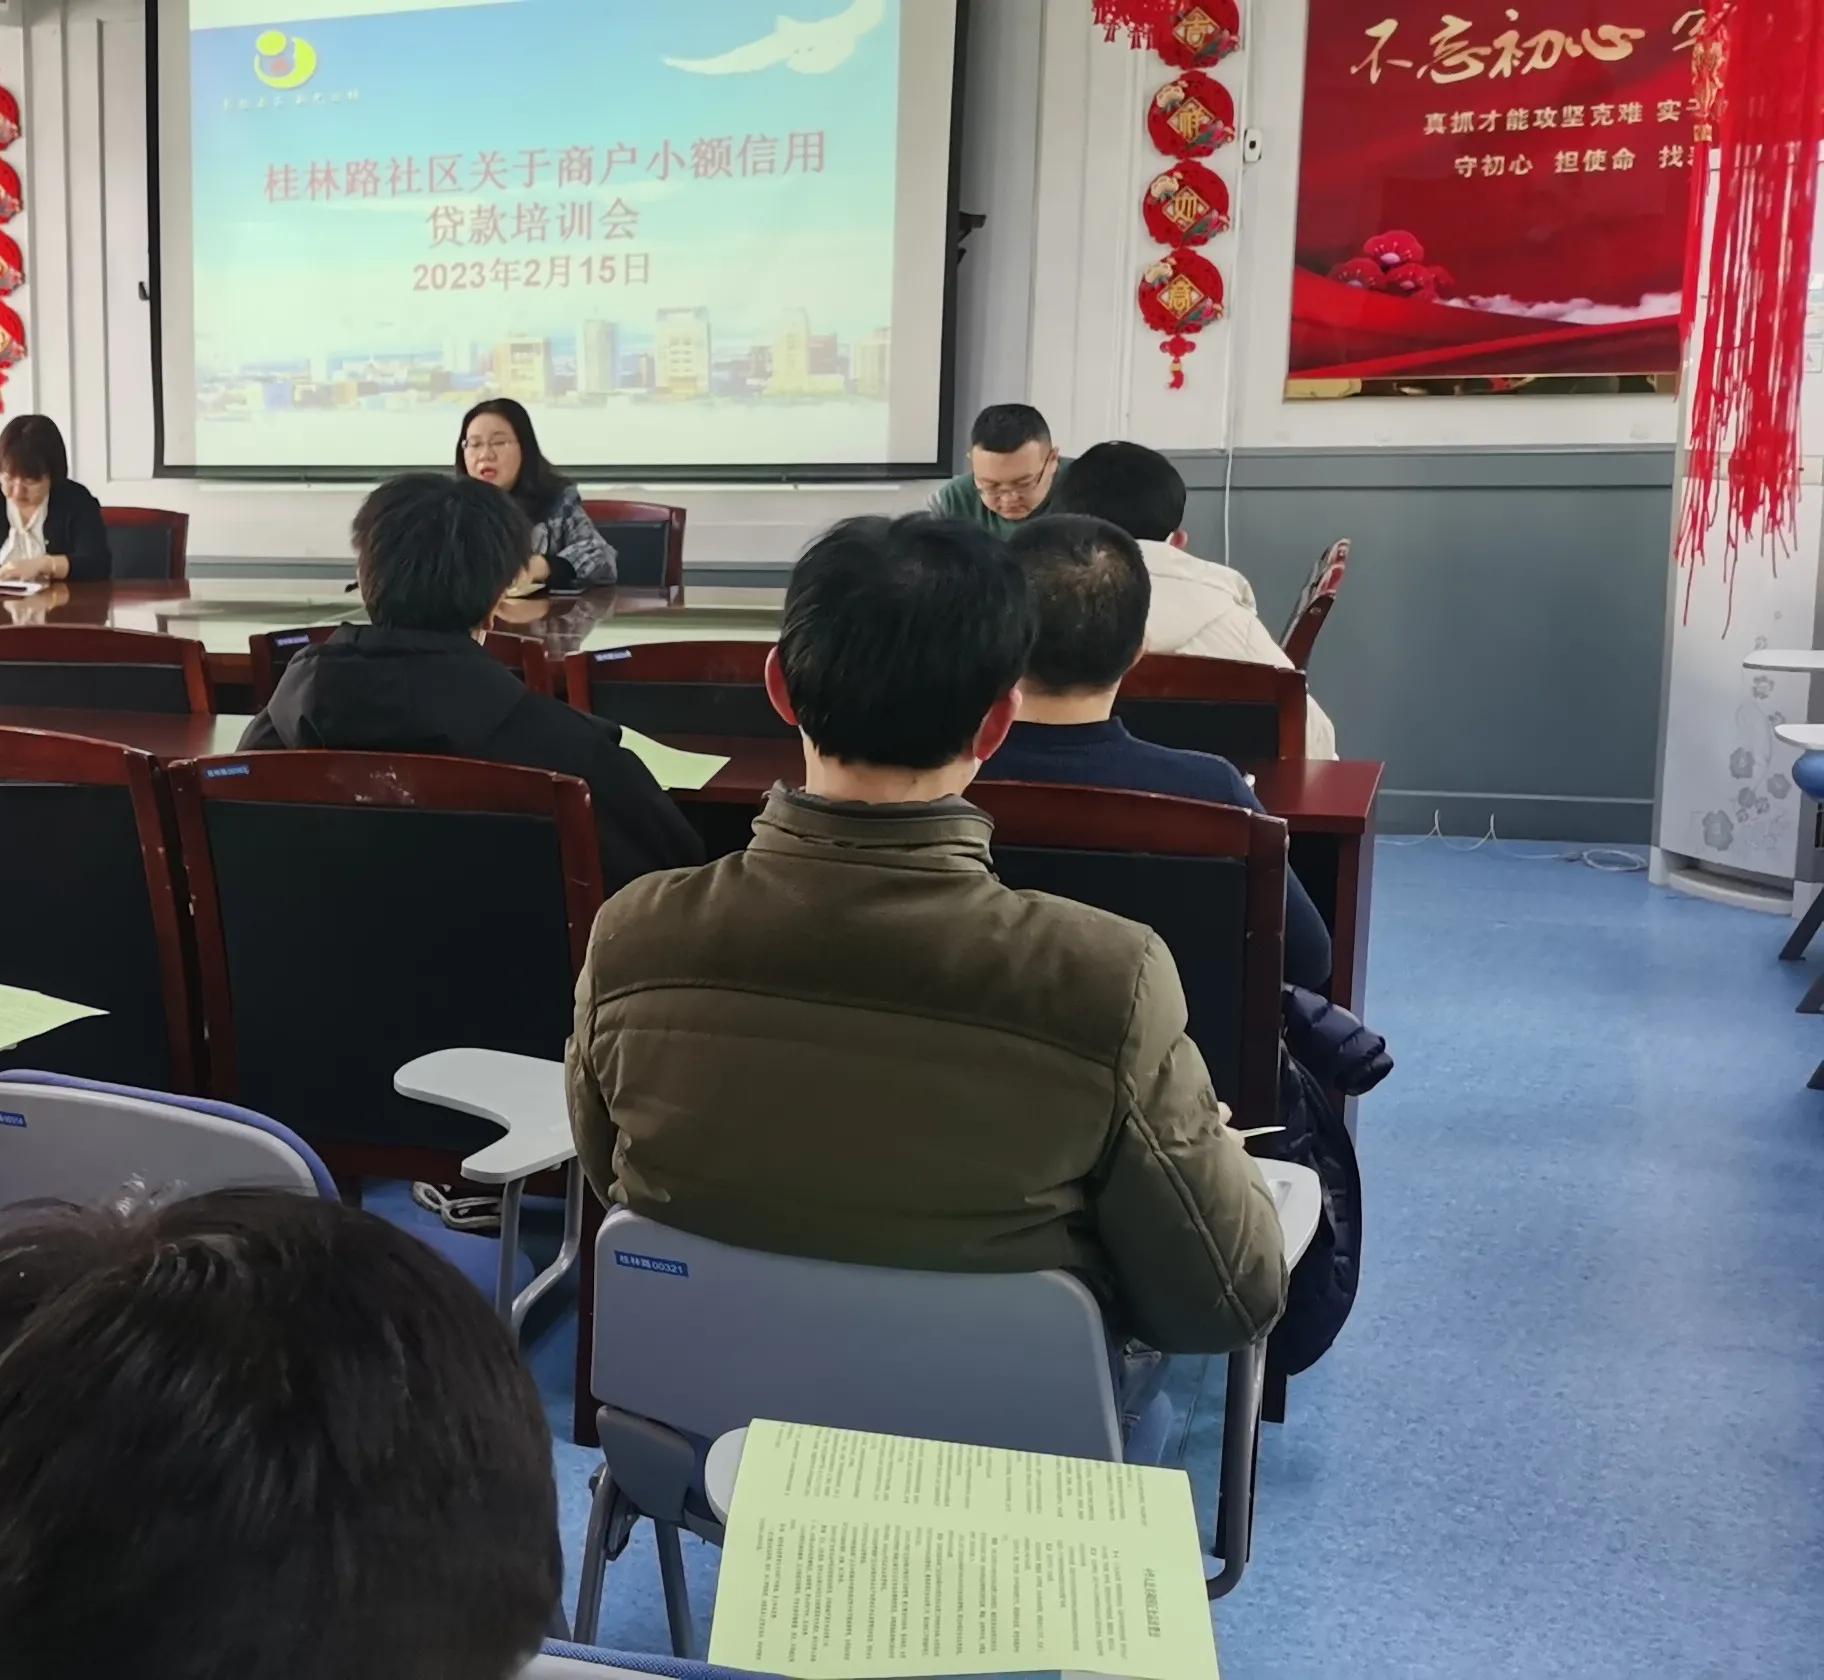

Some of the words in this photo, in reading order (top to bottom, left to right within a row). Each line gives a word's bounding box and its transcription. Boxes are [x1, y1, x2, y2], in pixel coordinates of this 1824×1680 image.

[1350, 9, 1646, 84] 不忘初心
[1423, 102, 1643, 135] 真抓才能攻坚克难
[264, 130, 826, 203] 桂林路社区关于商户小额信用
[1454, 153, 1533, 179] 守初心
[1554, 147, 1636, 174] 担使命
[425, 197, 640, 249] 贷款培训会
[412, 252, 650, 292] 2023年2月15日
